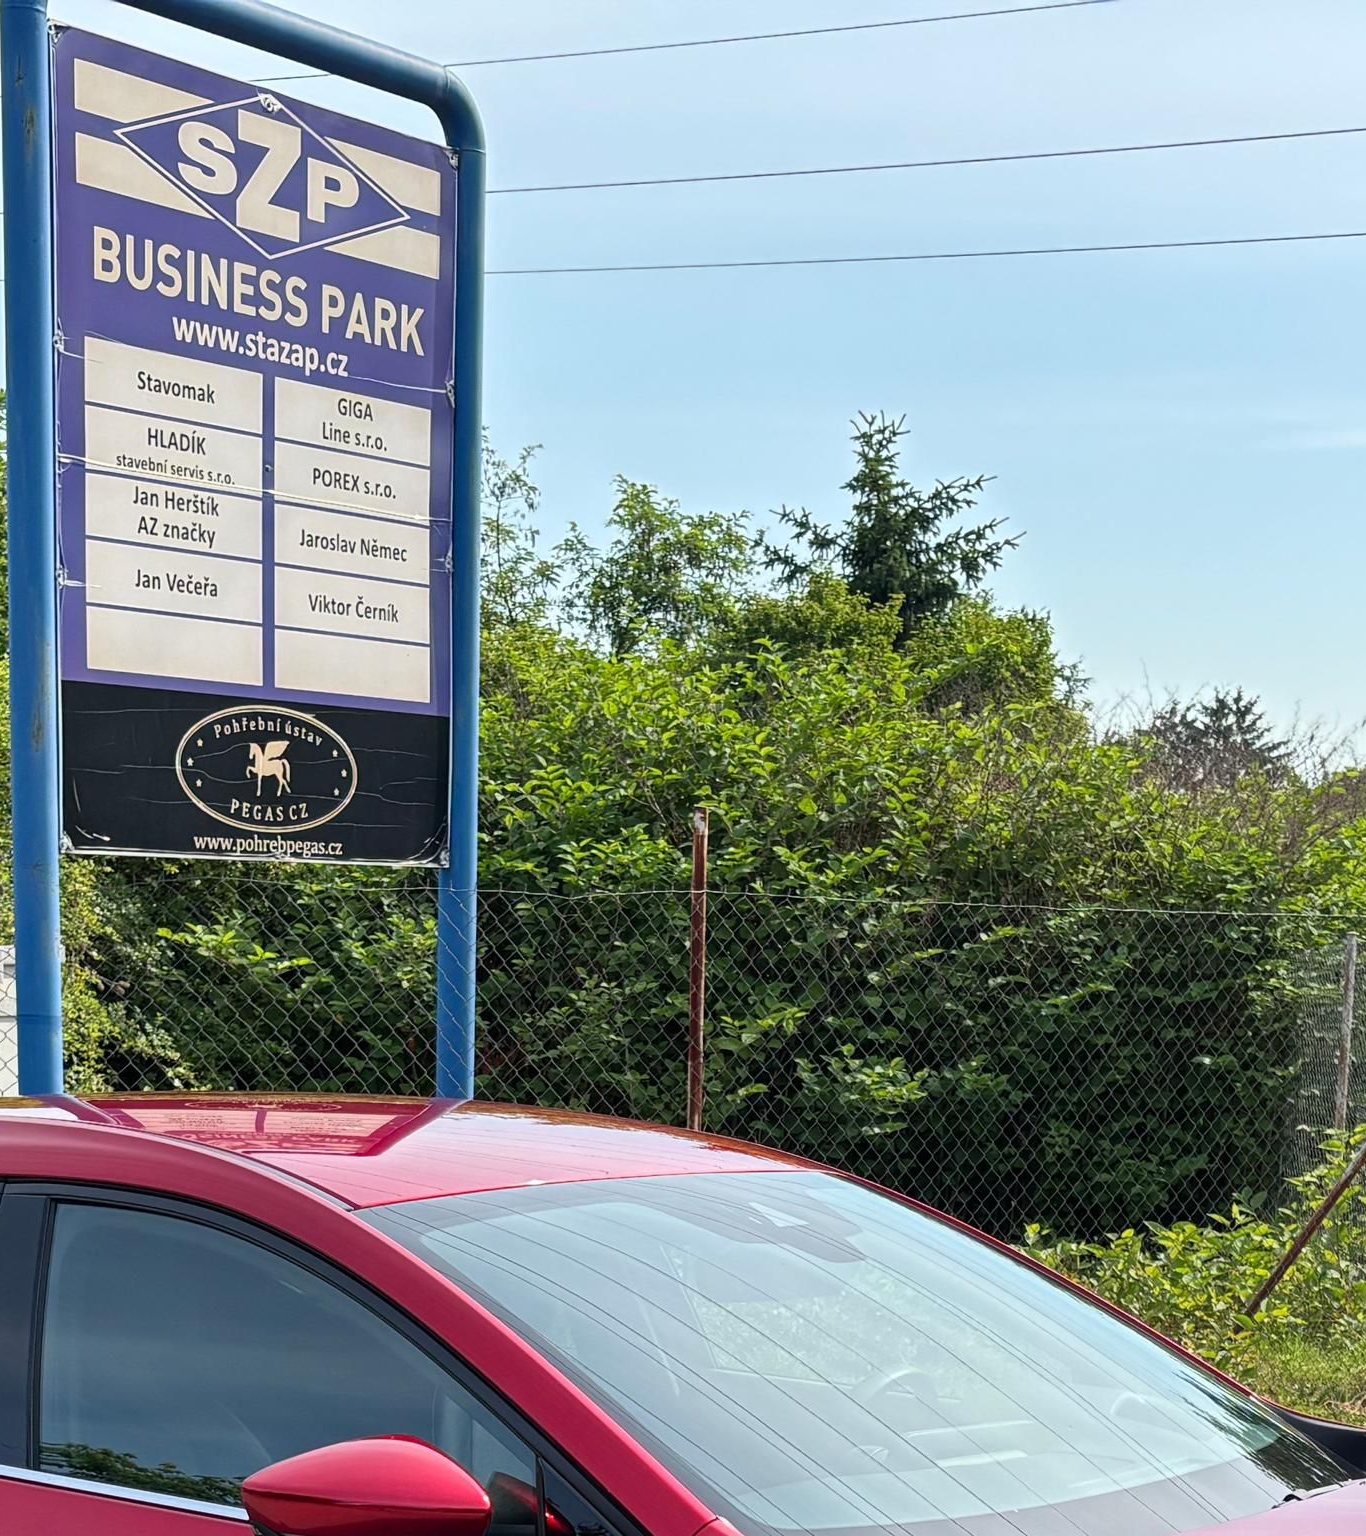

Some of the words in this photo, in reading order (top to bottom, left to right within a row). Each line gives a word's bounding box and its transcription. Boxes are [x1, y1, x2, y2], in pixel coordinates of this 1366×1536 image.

[177, 108, 360, 244] SZP
[93, 225, 309, 328] BUSINESS
[321, 283, 425, 357] PARK
[172, 316, 349, 377] www.stazap.cz
[137, 371, 216, 405] Stavomak
[337, 398, 374, 422] GIGA
[147, 427, 207, 456] HLADÍK
[322, 422, 351, 446] Line
[354, 432, 388, 452] s.r.o.
[116, 454, 168, 476] stavební
[170, 462, 205, 481] servis
[207, 469, 236, 486] s.r.o.
[312, 468, 360, 494] POREX
[364, 481, 397, 500] s.r.o.
[133, 486, 160, 508] Jan
[164, 490, 220, 518] Herštík
[137, 516, 160, 538] AZ
[163, 519, 217, 549] značky
[299, 528, 357, 555] Jaroslav
[360, 537, 408, 563] Němec
[135, 569, 162, 591] Jan
[166, 573, 219, 598] Večeřa
[308, 593, 352, 618] Viktor
[355, 594, 399, 624] Černík
[213, 716, 282, 739] Pohřební
[285, 720, 323, 746] ústav
[230, 798, 285, 821] PEGAS
[288, 802, 310, 822] CZ
[193, 834, 343, 857] www.pohrebpegas.cz
